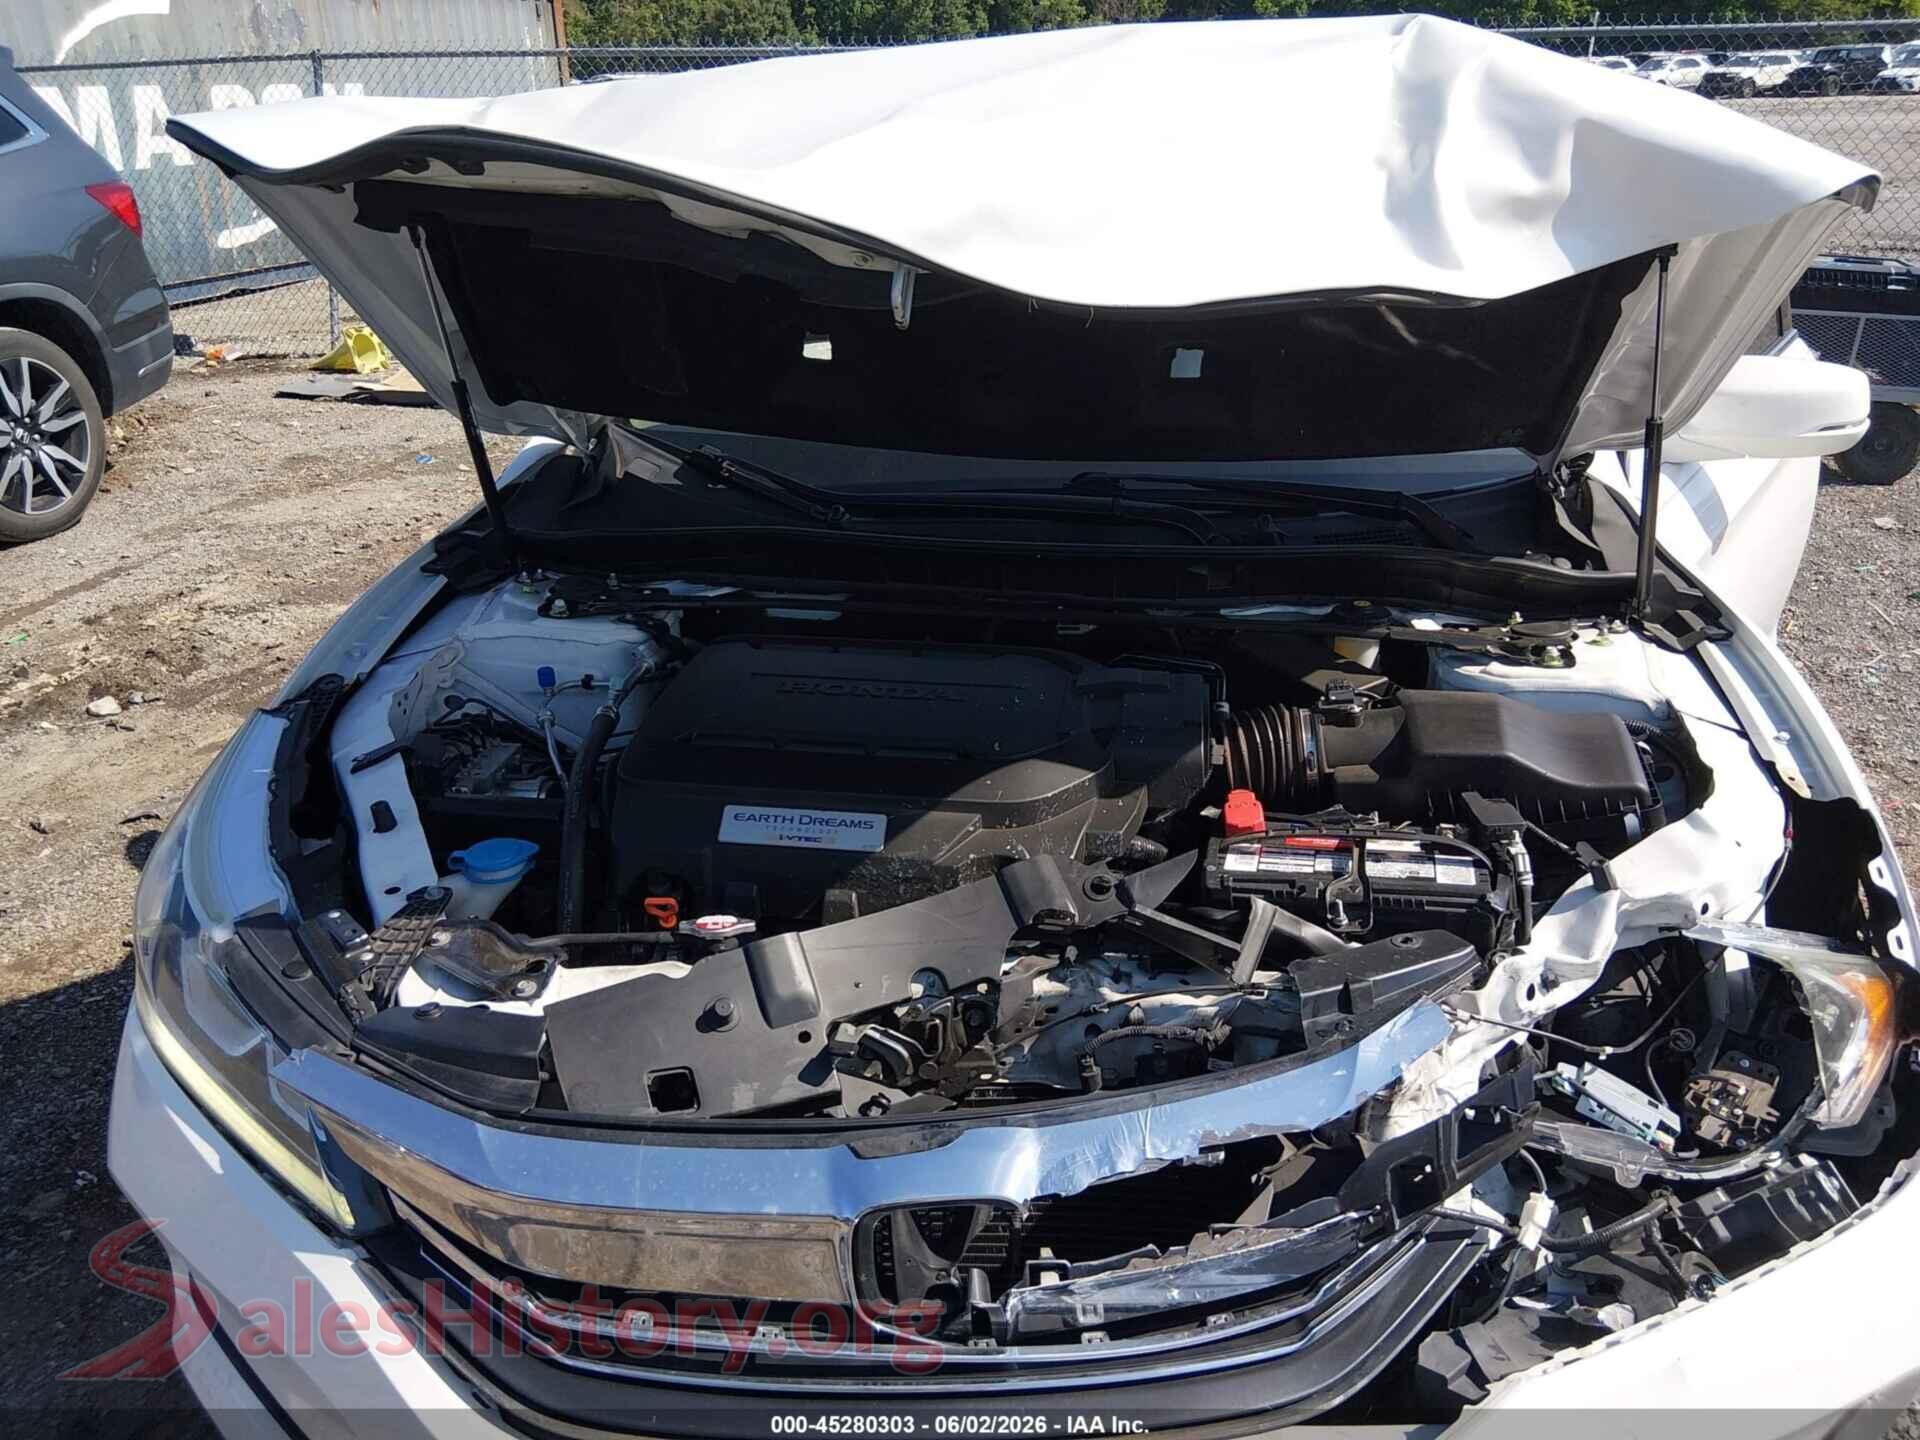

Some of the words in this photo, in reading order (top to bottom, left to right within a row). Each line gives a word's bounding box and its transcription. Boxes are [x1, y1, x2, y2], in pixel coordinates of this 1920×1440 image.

[776, 680, 966, 702] HONDA
[733, 812, 794, 824] EARTH
[799, 814, 875, 830] DREAMS
